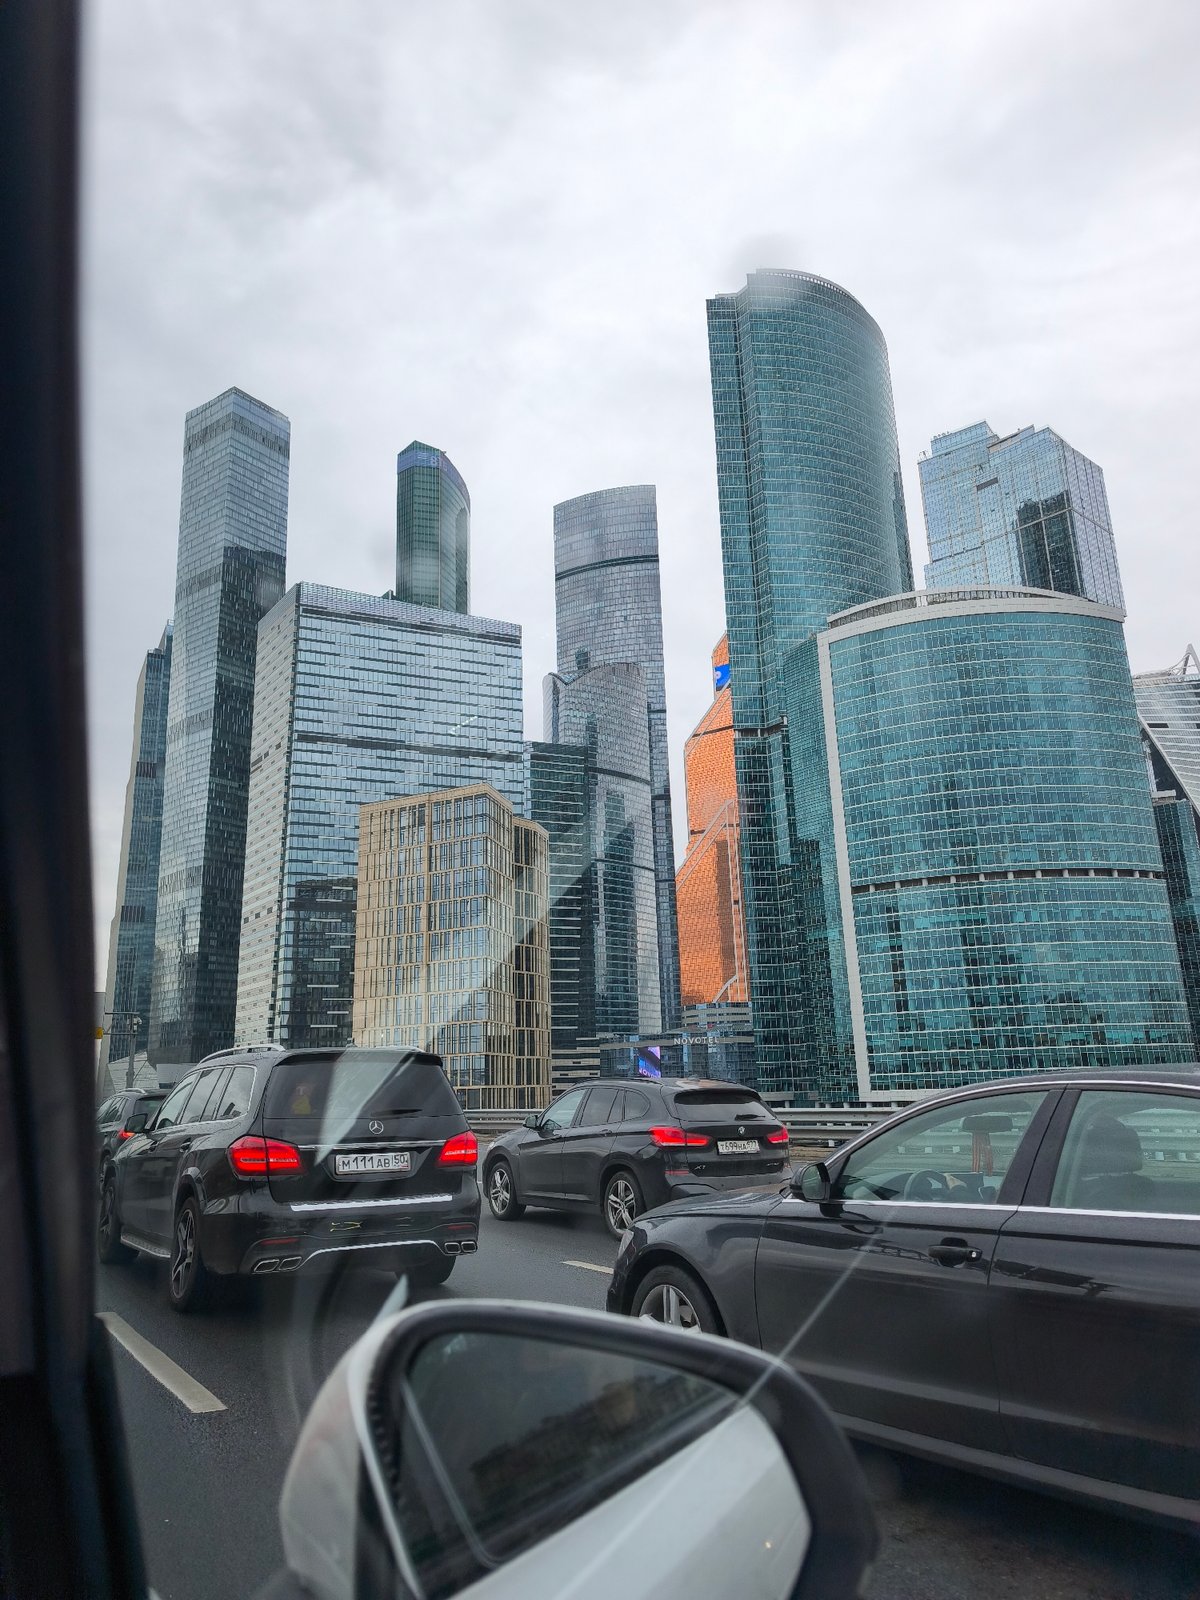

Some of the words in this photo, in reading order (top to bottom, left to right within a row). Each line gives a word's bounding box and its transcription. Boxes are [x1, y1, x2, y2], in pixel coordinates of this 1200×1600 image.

[673, 1036, 719, 1045] NOVOTEL
[342, 1155, 390, 1170] М111АВ
[394, 1154, 405, 1164] 50
